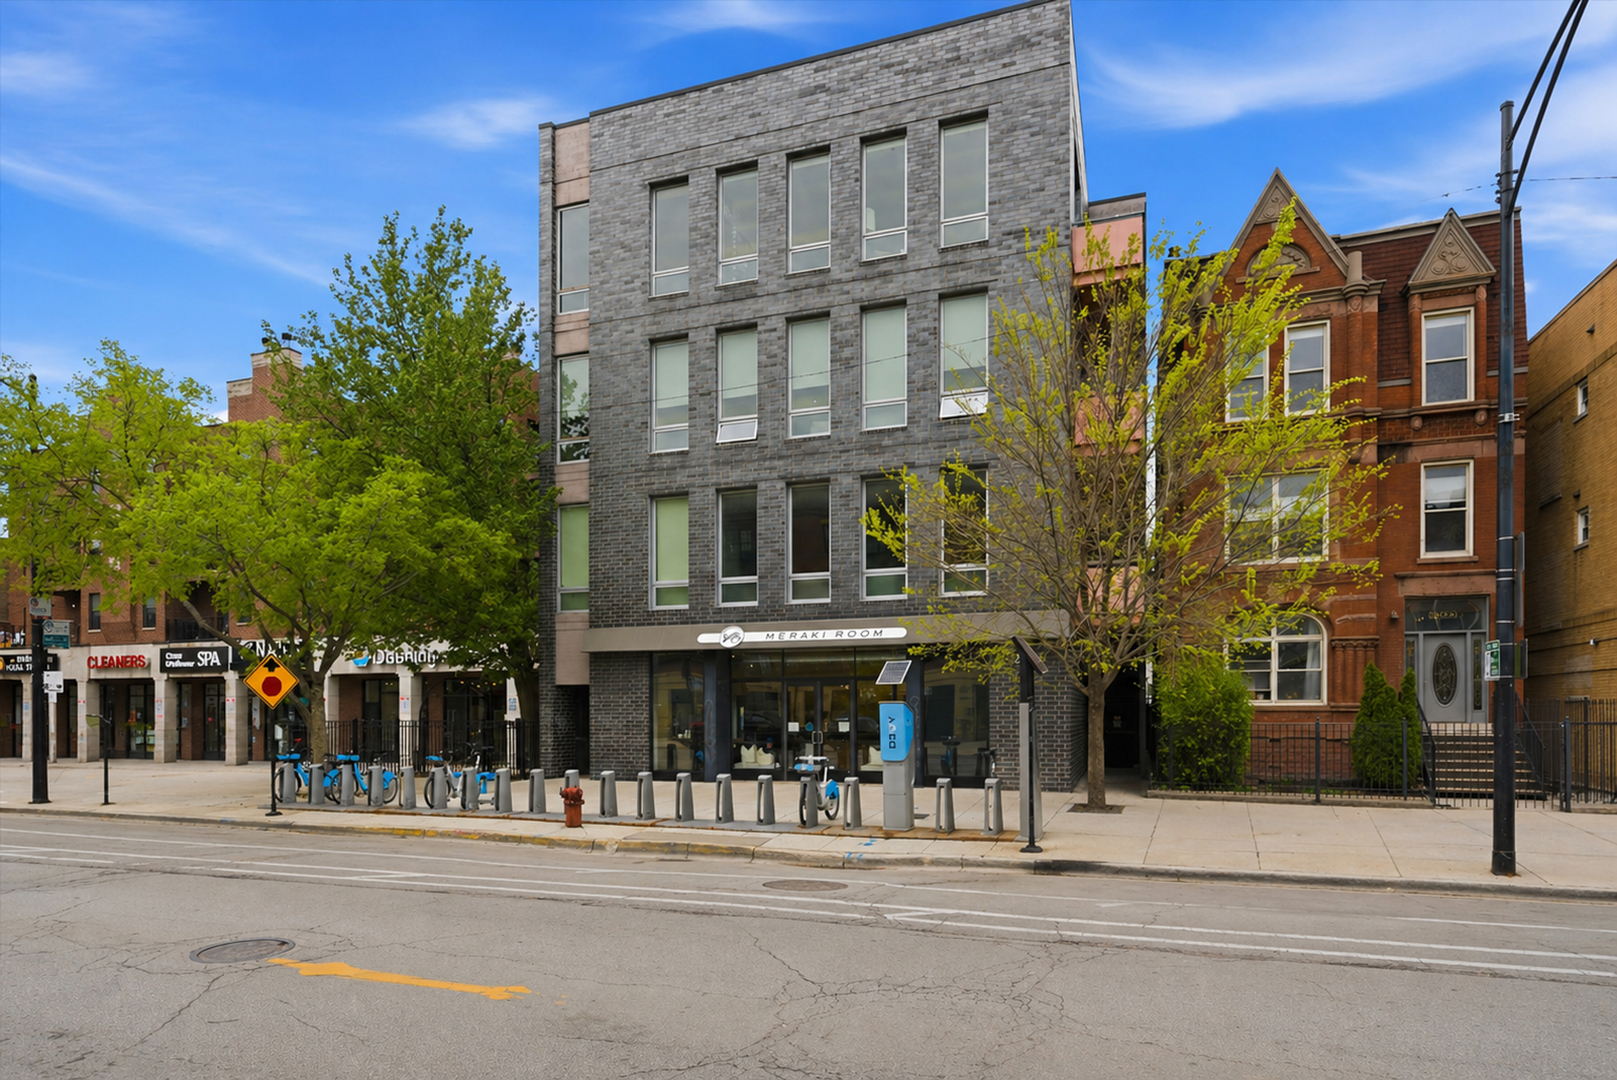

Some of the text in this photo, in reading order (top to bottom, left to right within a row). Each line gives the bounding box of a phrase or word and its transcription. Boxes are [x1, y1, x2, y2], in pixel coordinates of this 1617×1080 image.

[765, 629, 883, 640] MERAKI ROOM
[86, 655, 146, 669] CLEANERS
[197, 650, 222, 667] SPA
